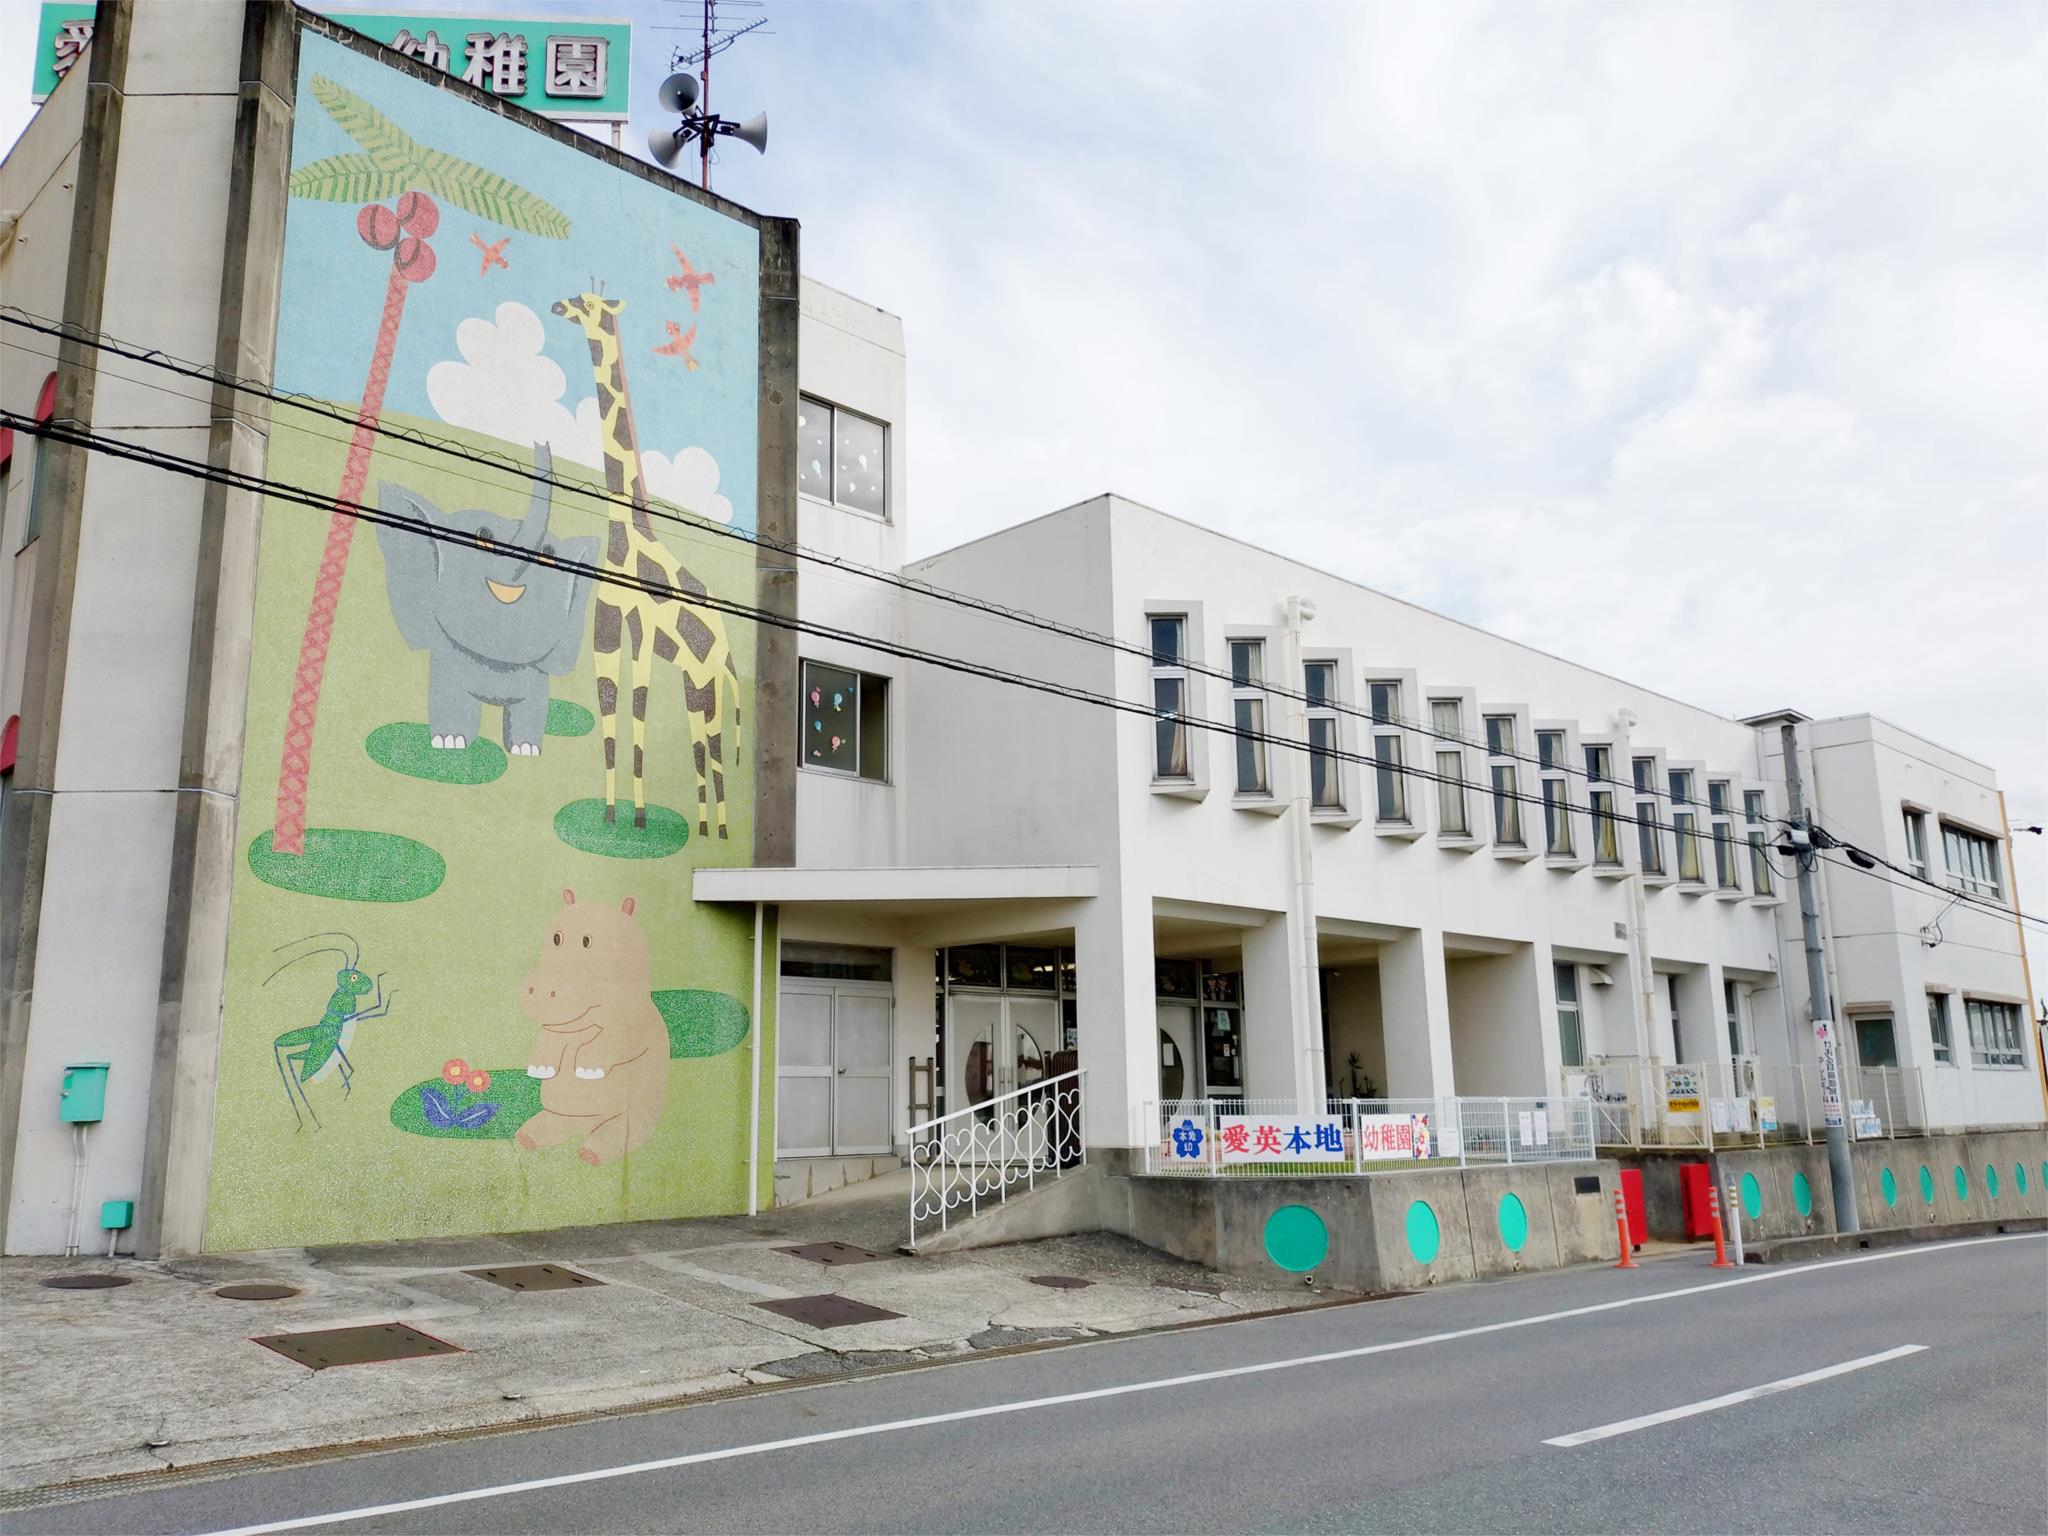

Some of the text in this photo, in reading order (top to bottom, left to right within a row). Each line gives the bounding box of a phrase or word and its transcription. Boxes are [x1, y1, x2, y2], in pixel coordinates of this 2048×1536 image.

[1222, 1122, 1344, 1155] 愛英本地
[1363, 1123, 1412, 1153] 幼稚園
